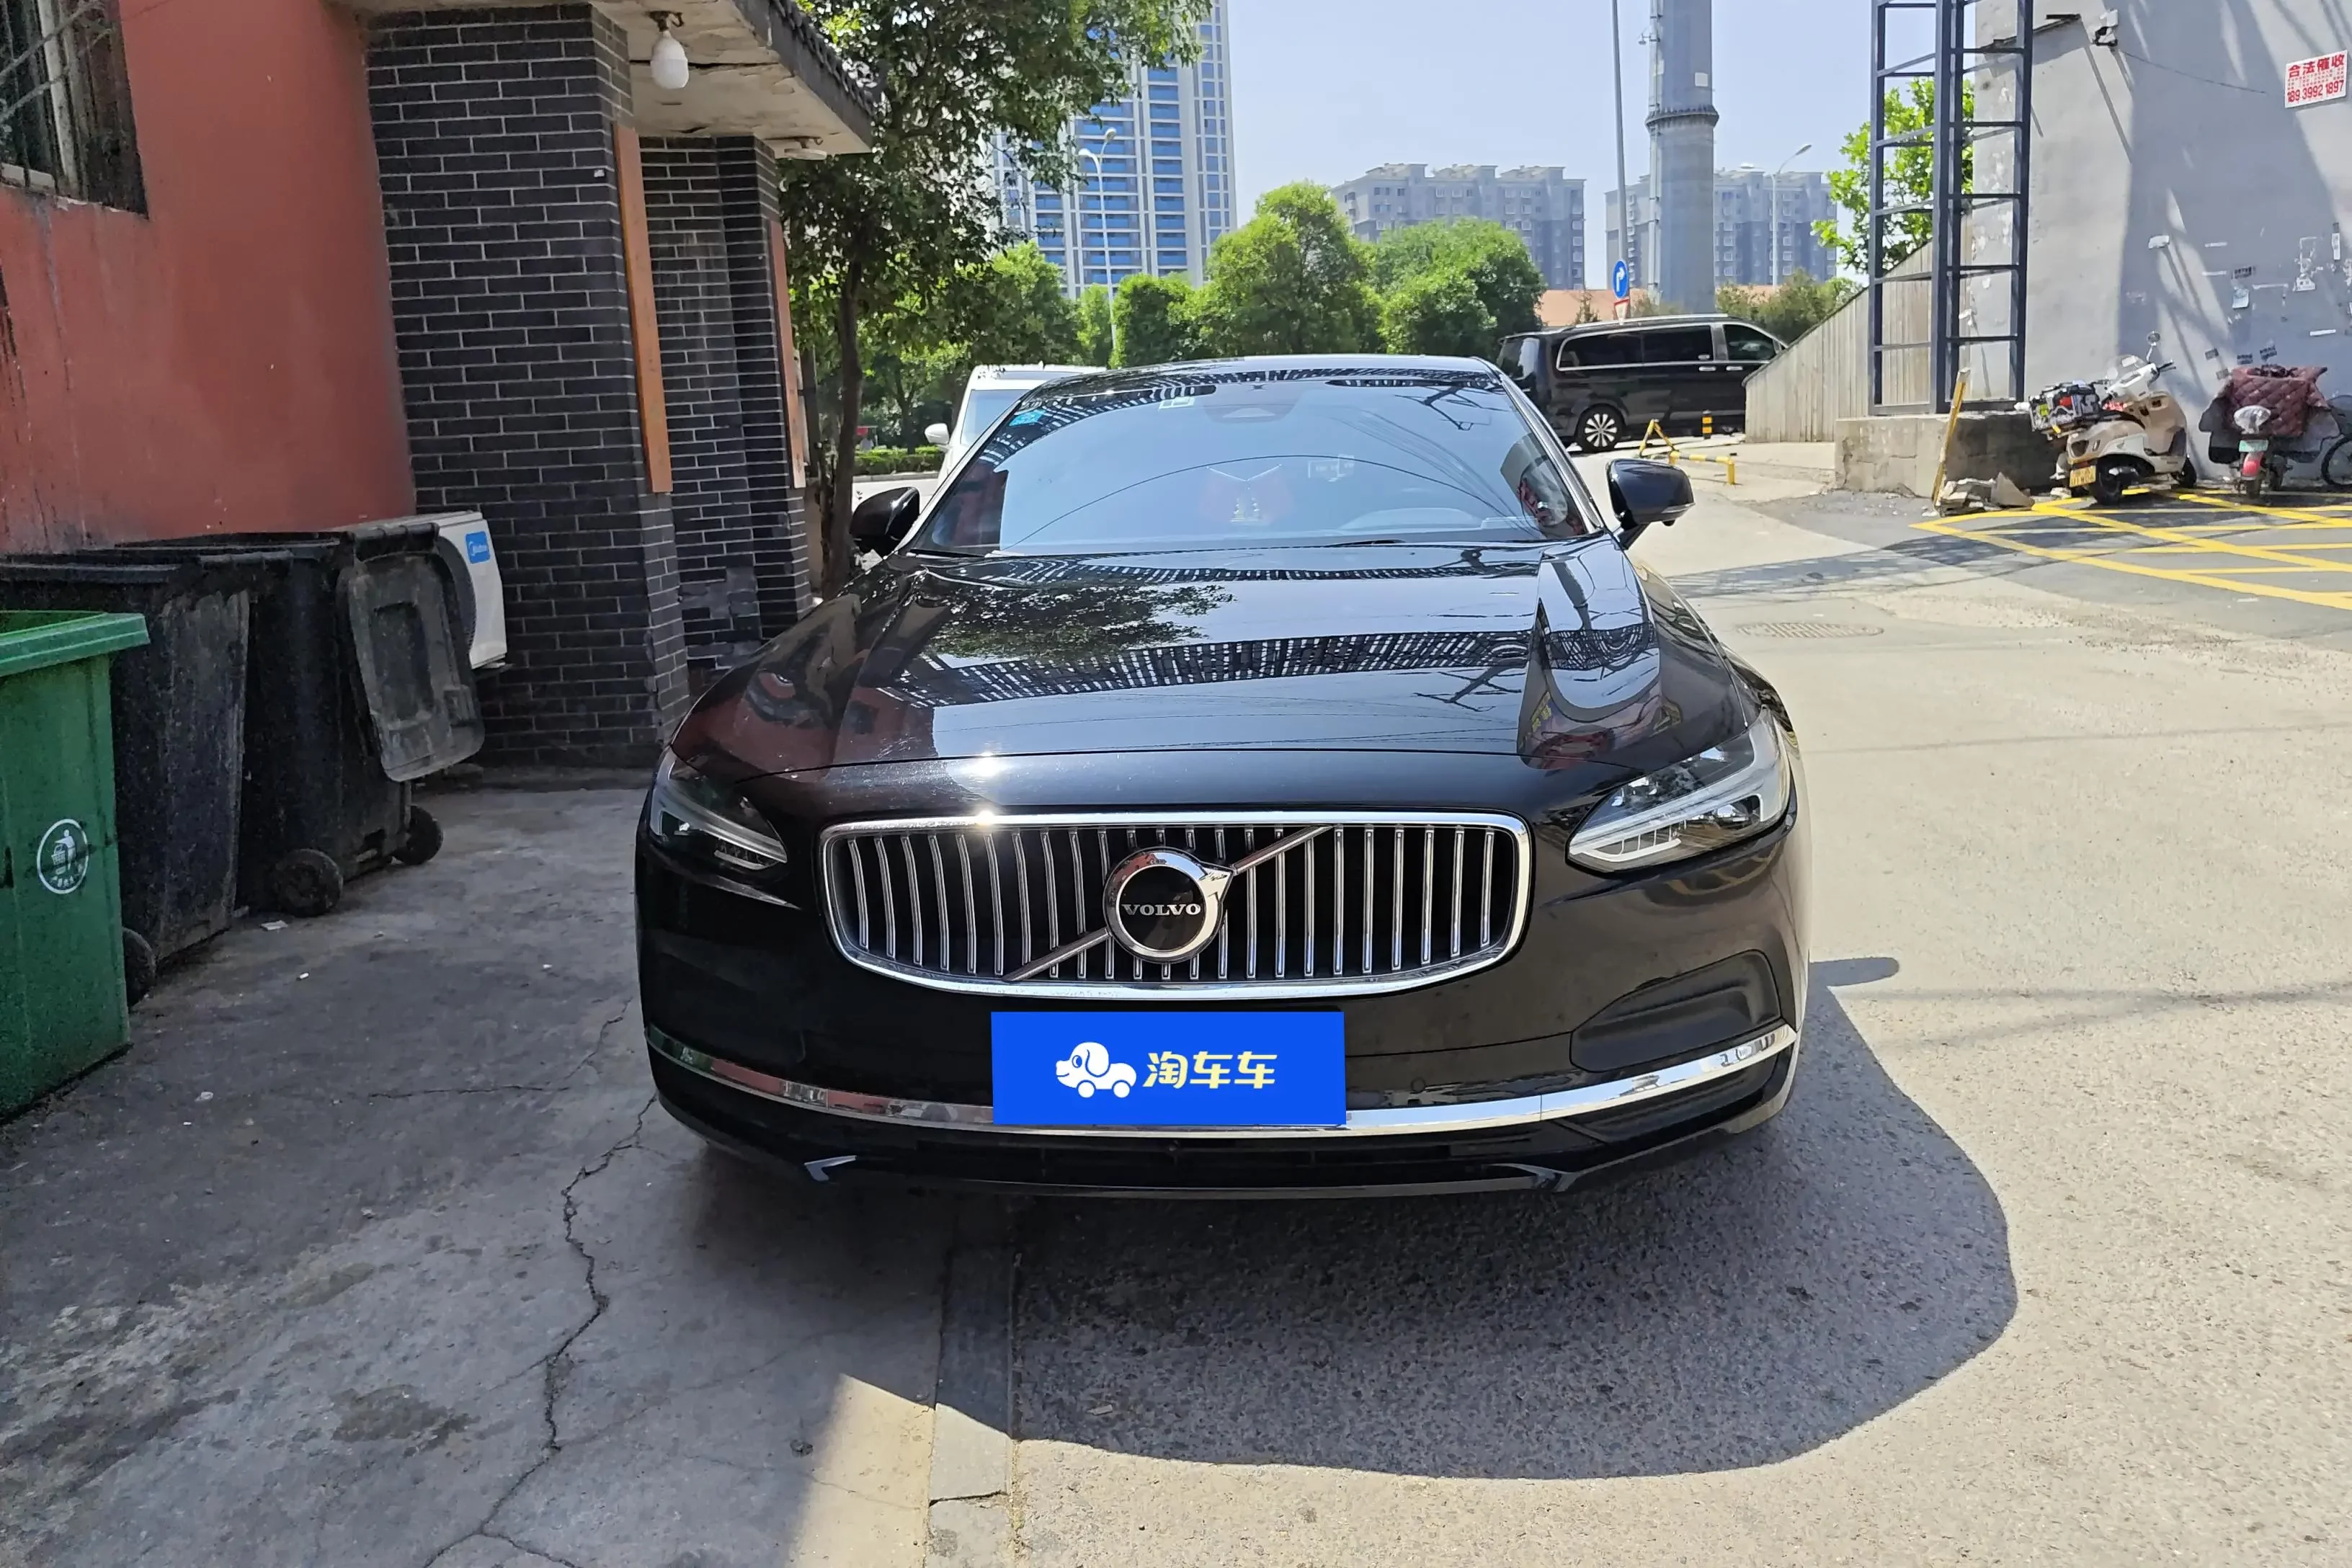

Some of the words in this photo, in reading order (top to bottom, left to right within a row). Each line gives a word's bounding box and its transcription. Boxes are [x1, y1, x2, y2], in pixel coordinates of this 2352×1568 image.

[2288, 54, 2345, 79] 合法催收
[2302, 84, 2323, 99] 3992
[2325, 80, 2344, 94] 1897
[1121, 903, 1201, 916] VOLVO
